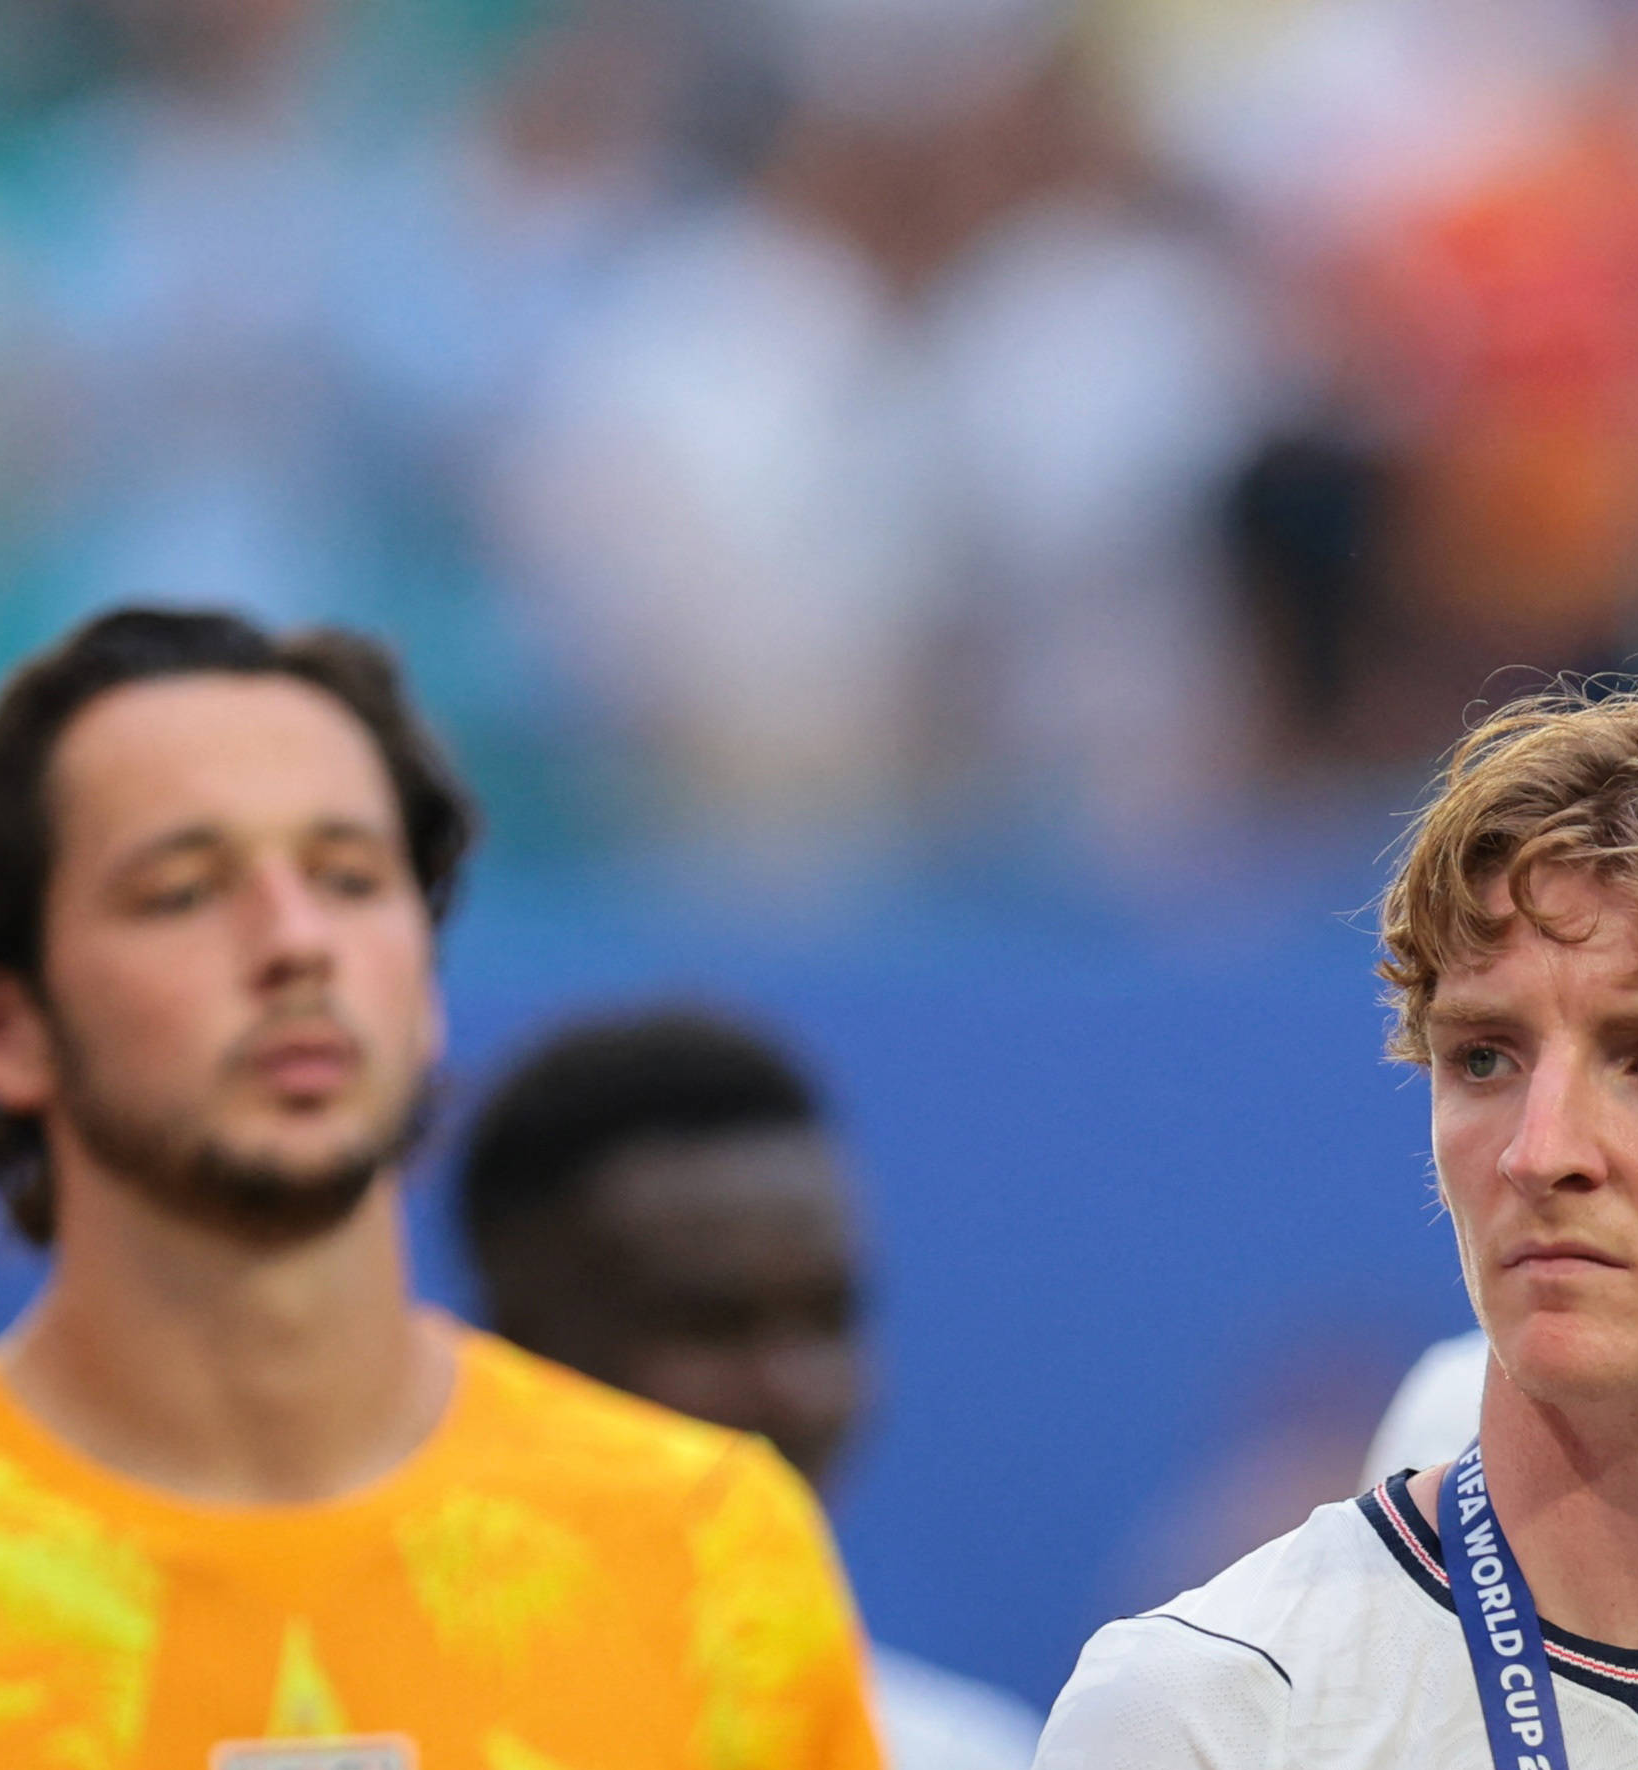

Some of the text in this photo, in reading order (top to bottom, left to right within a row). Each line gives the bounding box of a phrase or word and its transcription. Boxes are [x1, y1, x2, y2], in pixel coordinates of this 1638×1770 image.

[1457, 1445, 1488, 1526] FIFA
[1463, 1518, 1524, 1658] WORLD
[1499, 1663, 1545, 1748] CUP
